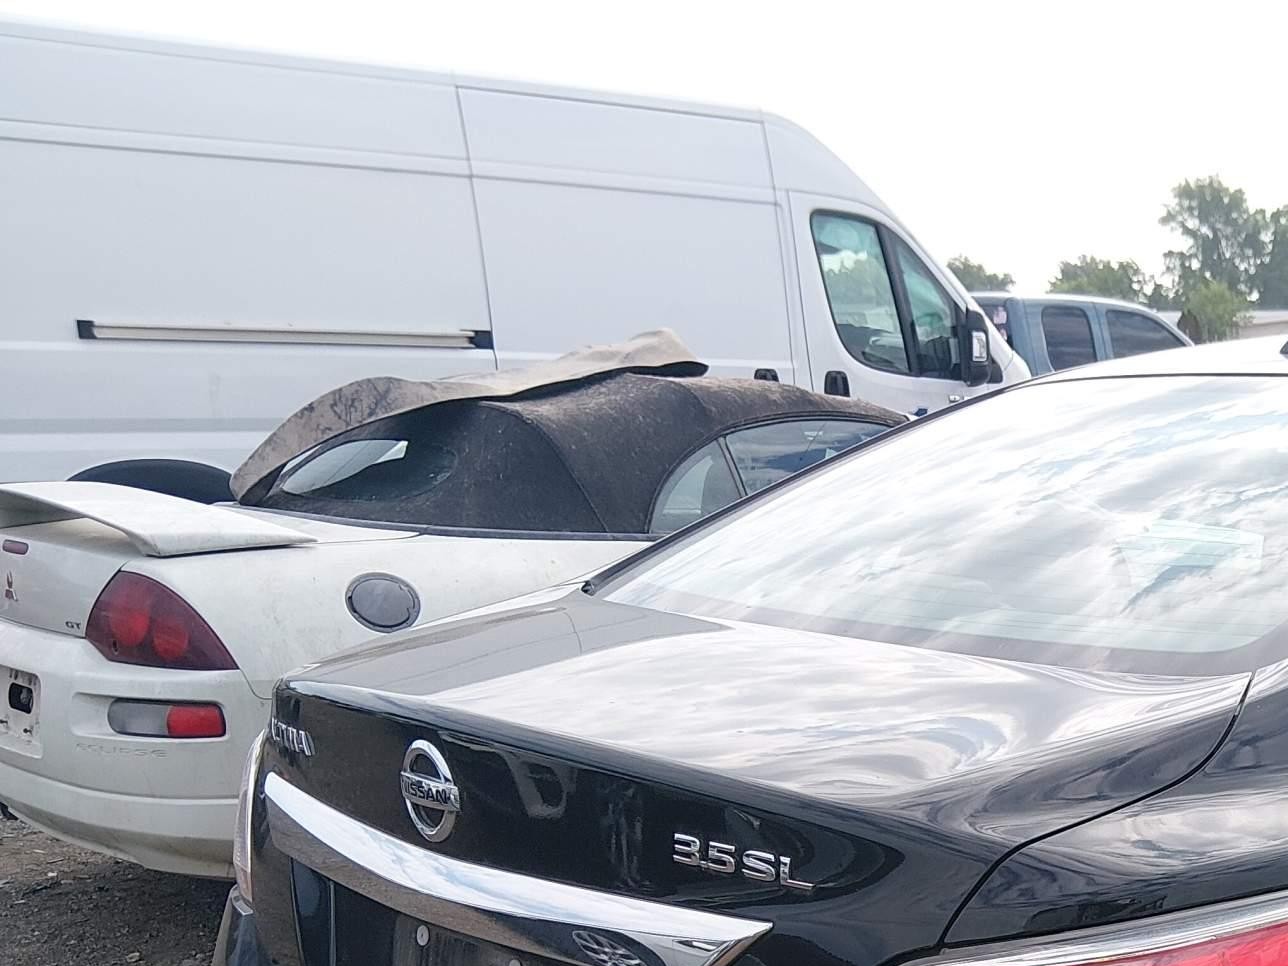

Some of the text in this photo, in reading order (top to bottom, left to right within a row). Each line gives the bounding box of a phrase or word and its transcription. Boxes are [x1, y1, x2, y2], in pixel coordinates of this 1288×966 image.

[65, 620, 82, 630] GT
[401, 776, 449, 805] NISSAN
[672, 832, 816, 890] 3.5 SL
